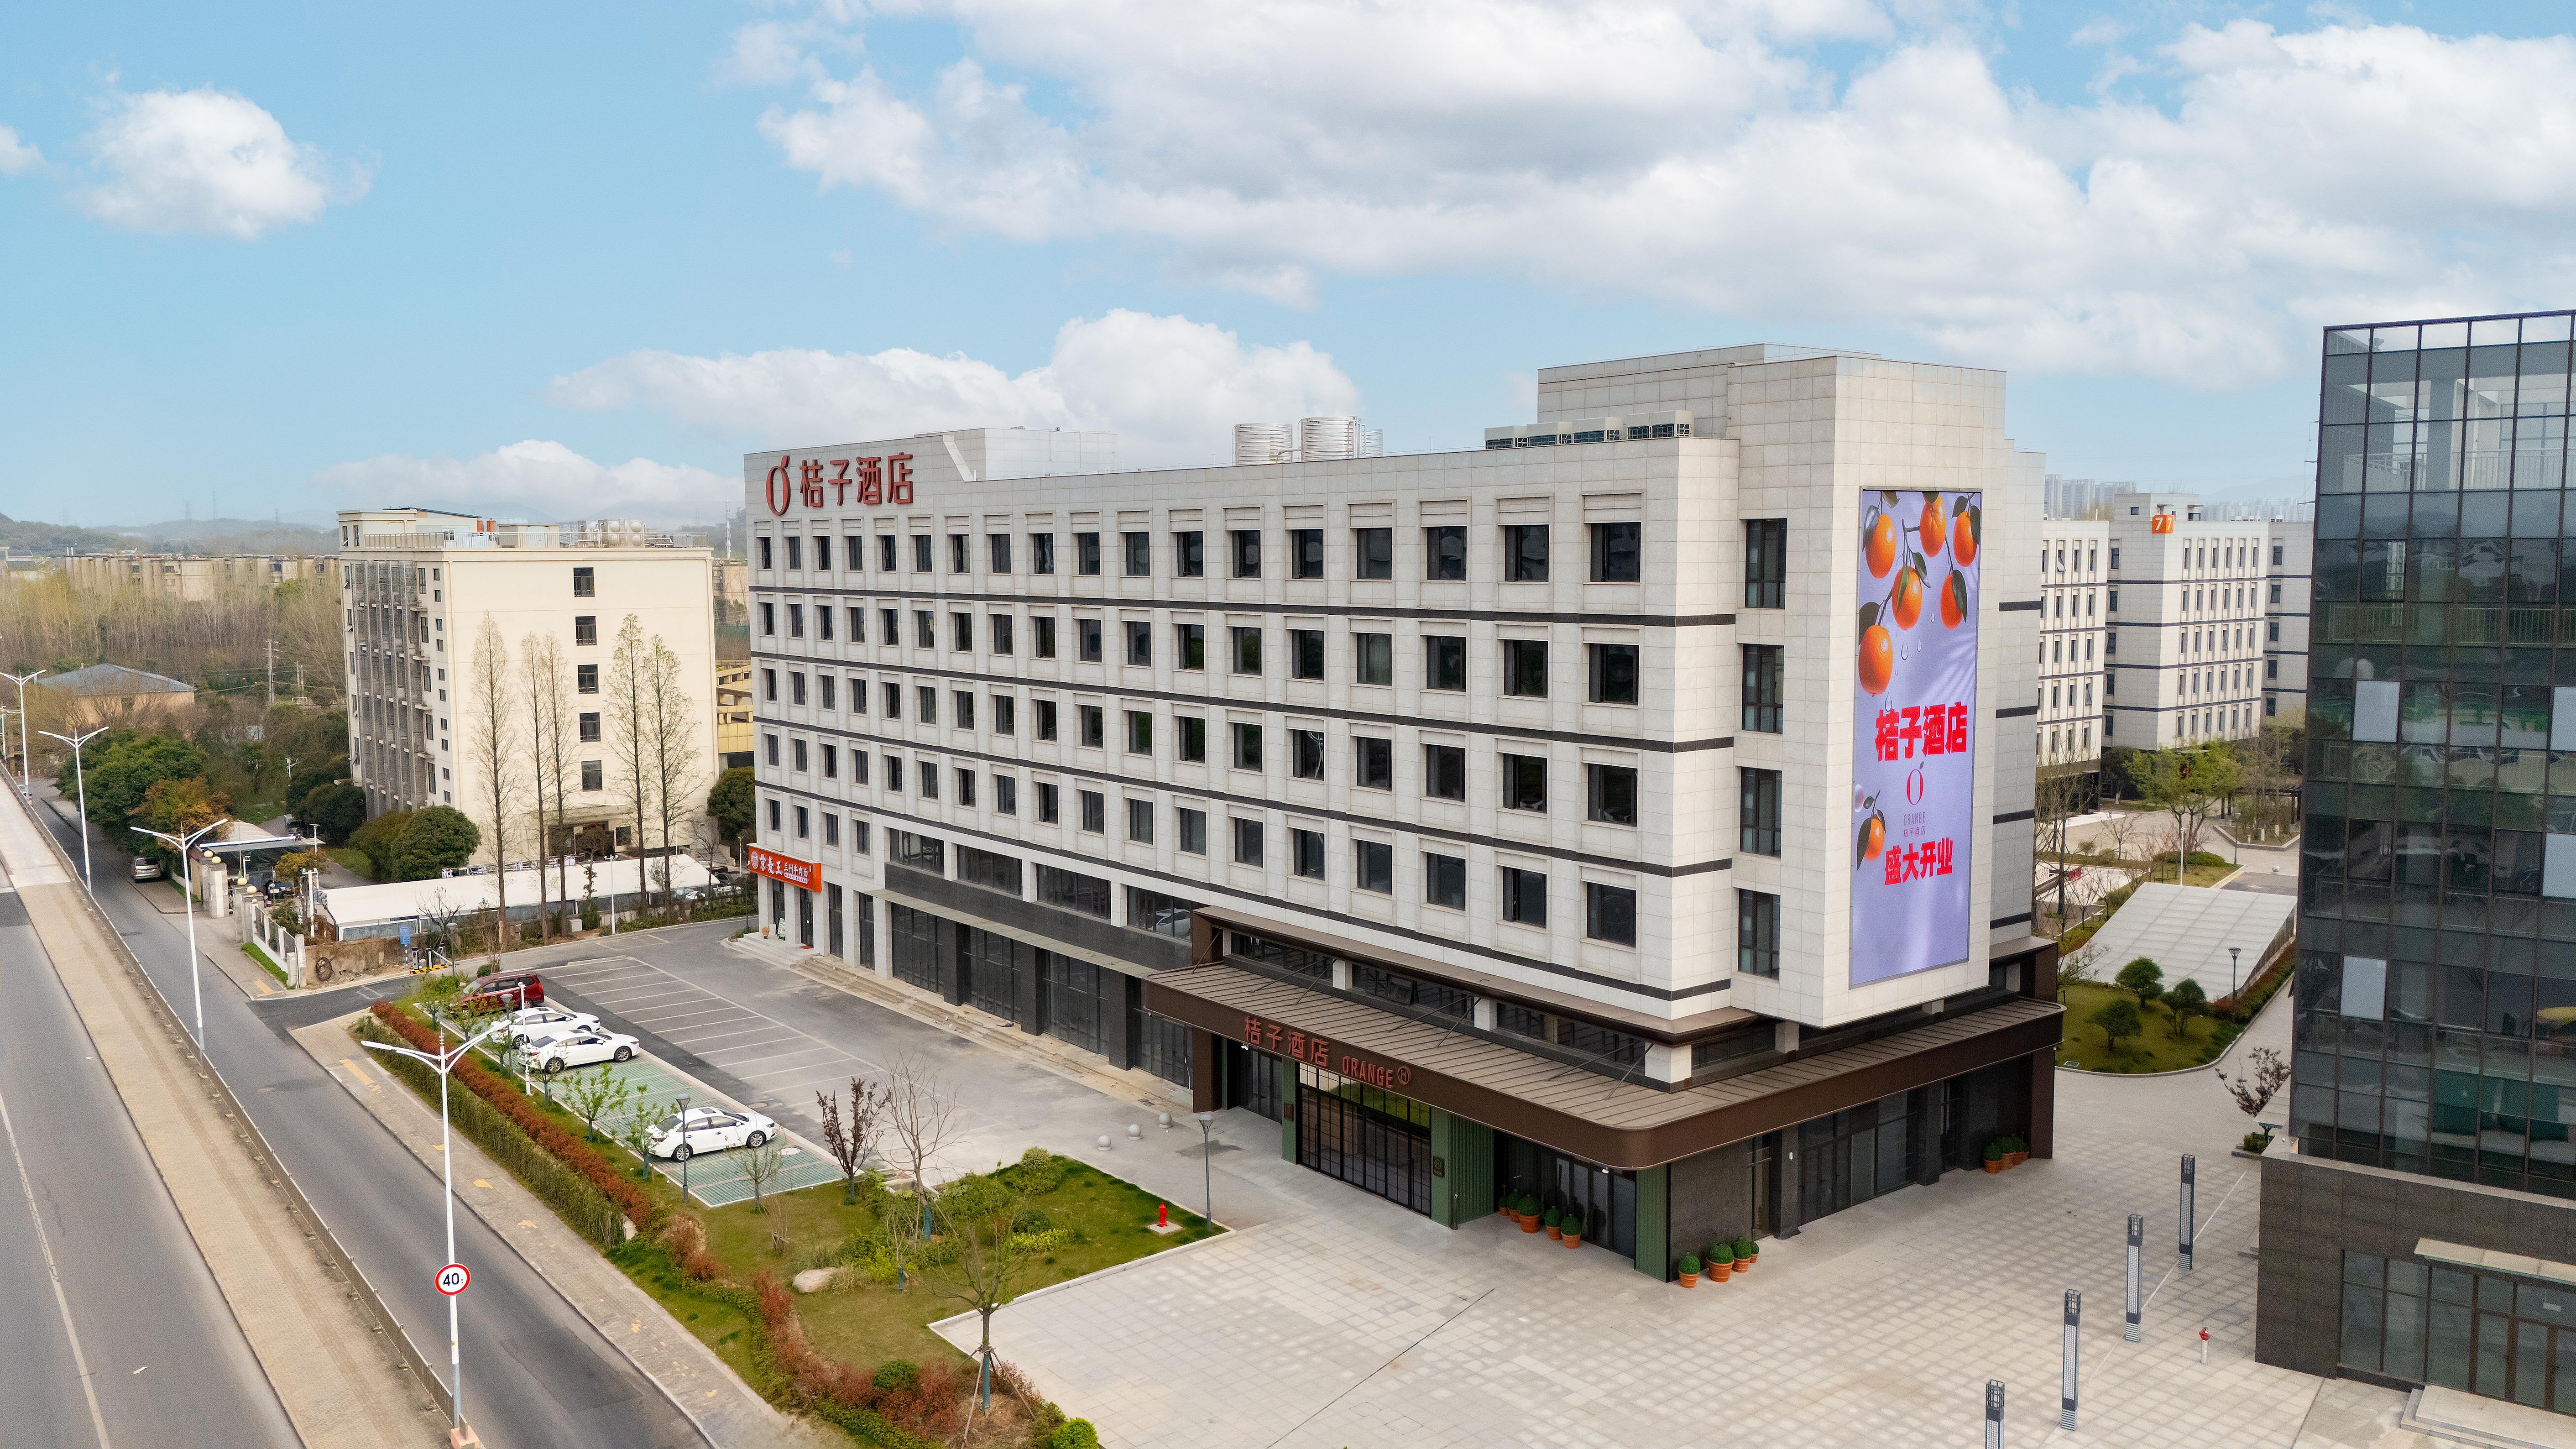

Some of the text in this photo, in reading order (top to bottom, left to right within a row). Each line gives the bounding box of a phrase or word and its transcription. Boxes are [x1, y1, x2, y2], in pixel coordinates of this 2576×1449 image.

[799, 452, 913, 507] 桔子酒店
[2155, 517, 2163, 530] 7
[2168, 517, 2172, 530] 7
[1874, 701, 1968, 762] 桔子酒店
[1903, 811, 1925, 826] ORANGE
[1904, 826, 1925, 837] 桔子酒店
[1884, 837, 1953, 885] 盛大开业
[784, 862, 808, 878] 兰州牛肉面
[1244, 1016, 1329, 1067] 桔子酒店
[1343, 1056, 1394, 1089] ORANGE
